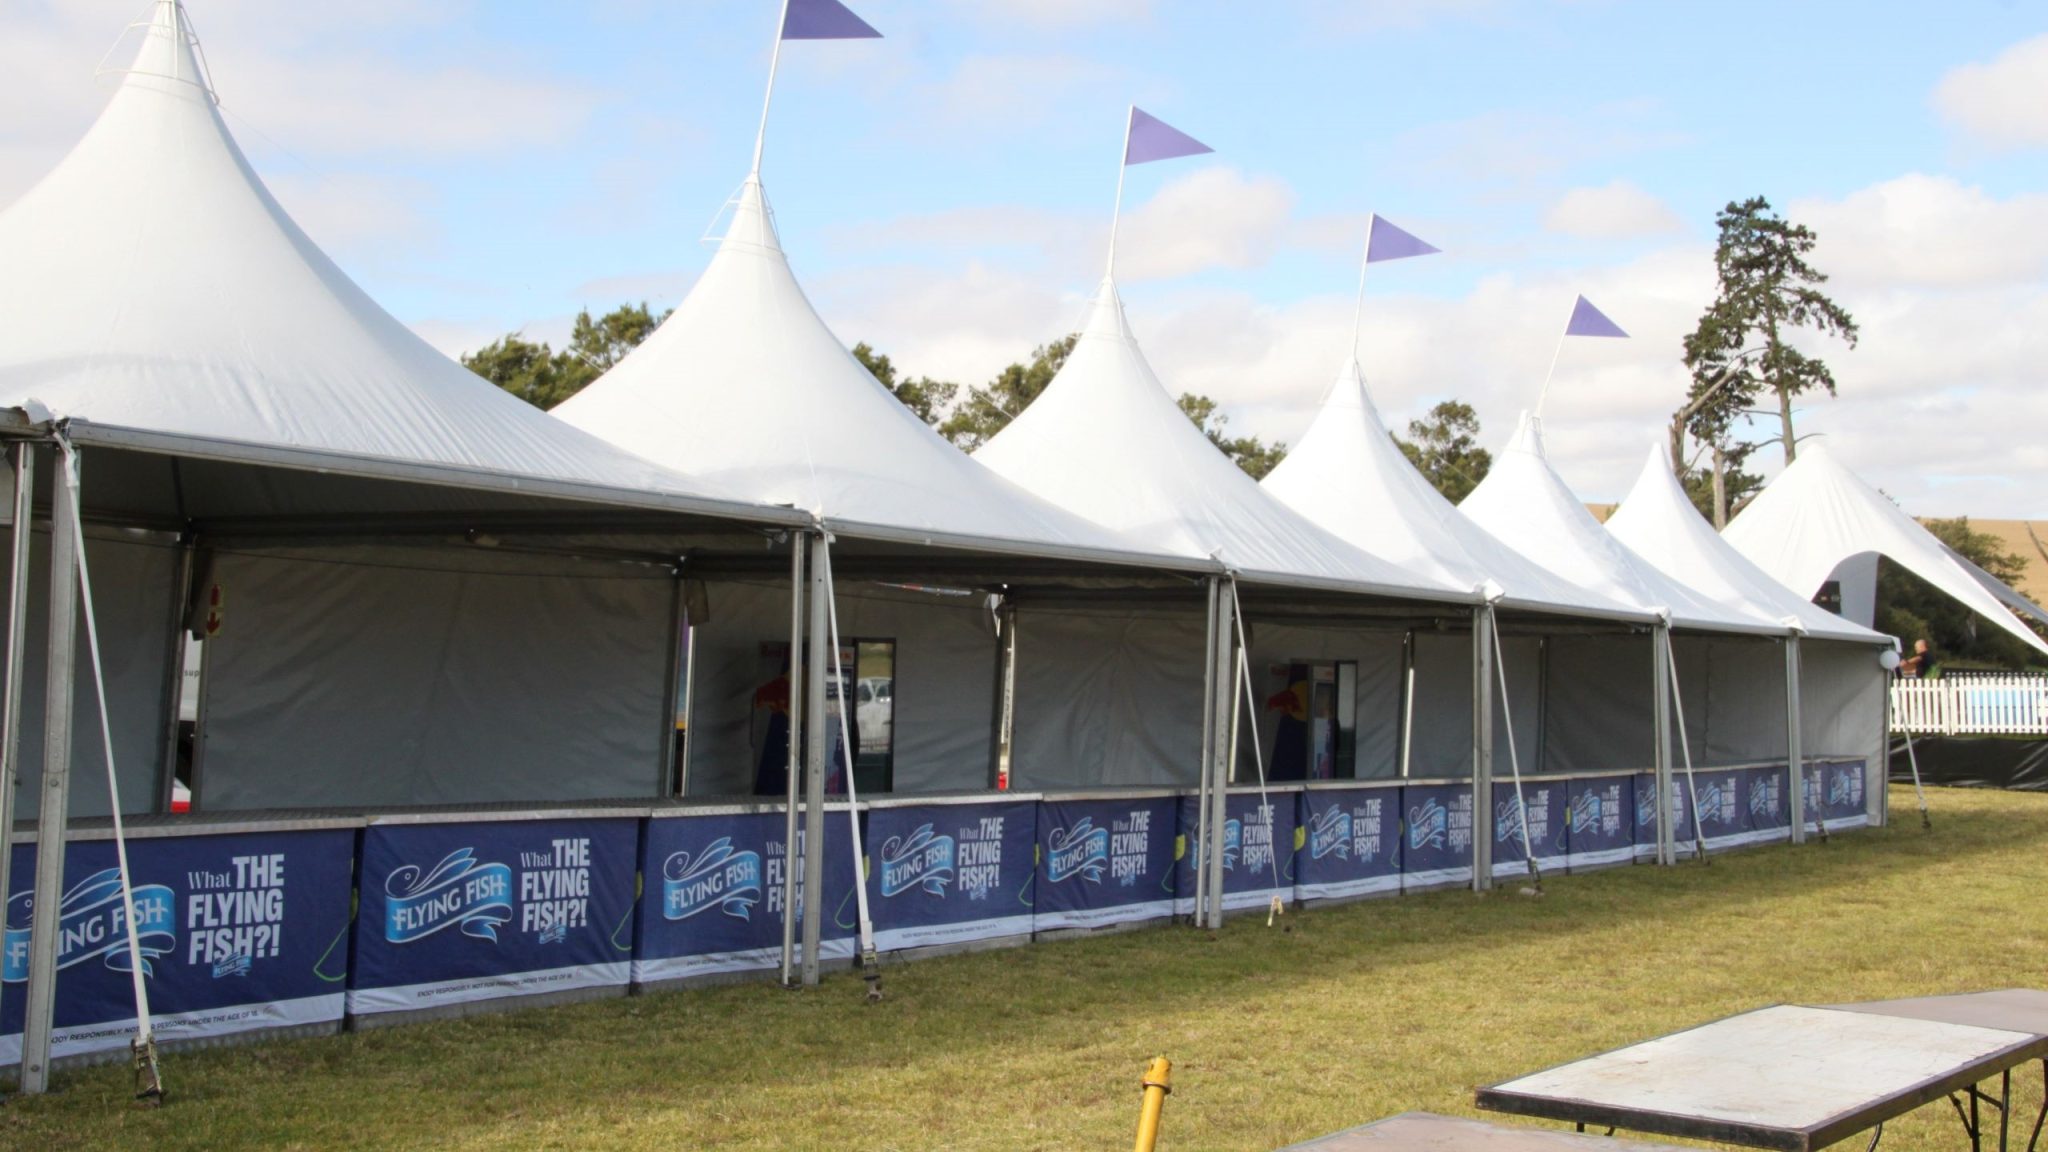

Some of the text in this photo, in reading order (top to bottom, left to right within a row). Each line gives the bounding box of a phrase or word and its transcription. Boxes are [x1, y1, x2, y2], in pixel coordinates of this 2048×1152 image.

[980, 817, 1004, 840] THE
[1130, 811, 1151, 832] THE
[520, 838, 590, 868] What THE
[958, 841, 1001, 866] FLYING
[1051, 836, 1105, 874] FLYING FISH
[1111, 832, 1148, 855] FLYING
[188, 854, 285, 889] What THE
[885, 844, 949, 887] FLYING FISH
[959, 865, 1000, 891] FISH?!
[521, 868, 590, 901] FLYING
[668, 858, 757, 910] FLYING FISH
[188, 891, 283, 928] FLYING
[391, 873, 507, 931] FLYING FISH
[522, 899, 588, 932] FISH?!
[7, 897, 168, 968] FING FSH
[188, 924, 280, 965] FISH?!
[213, 1014, 226, 1022] THE
